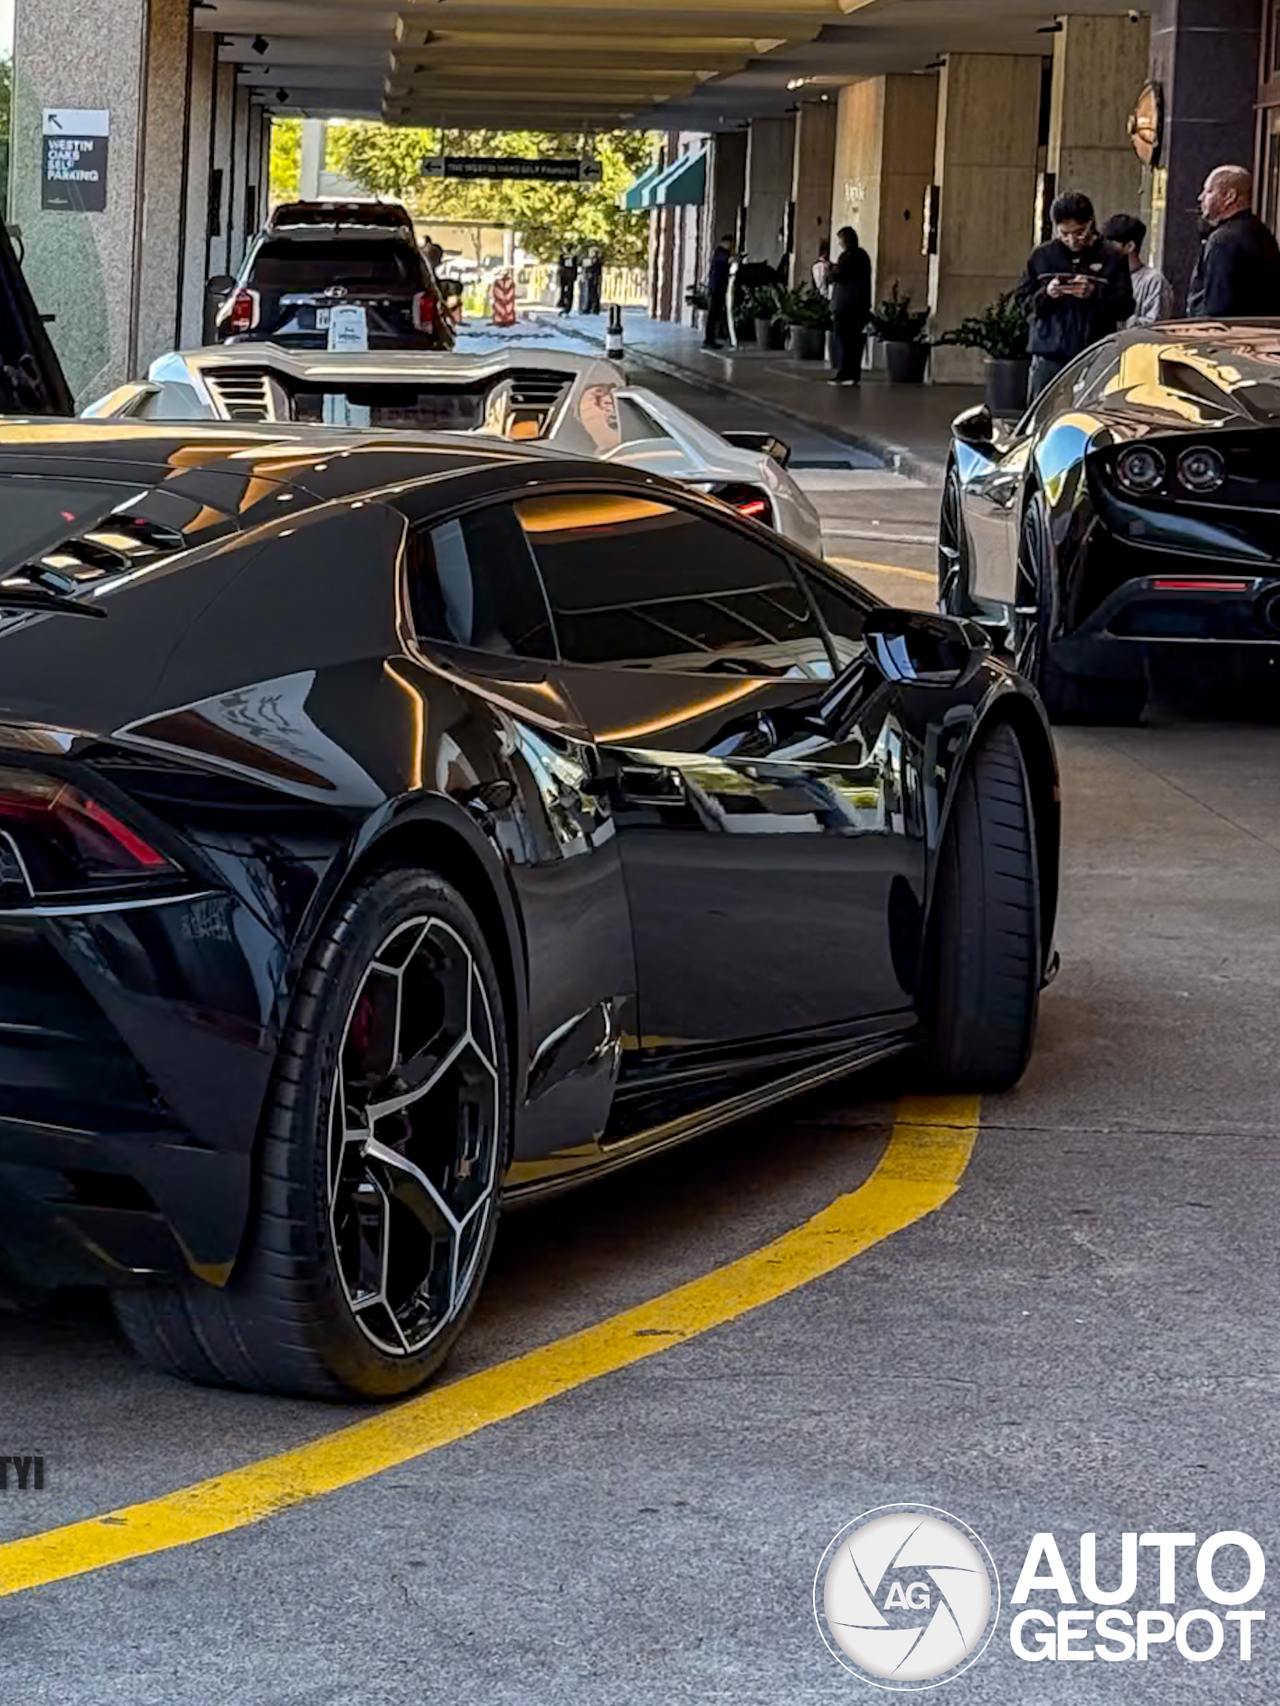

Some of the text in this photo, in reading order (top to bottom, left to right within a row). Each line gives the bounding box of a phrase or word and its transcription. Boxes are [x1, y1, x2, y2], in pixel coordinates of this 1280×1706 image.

[47, 140, 94, 151] WESTIN
[47, 150, 80, 161] OAKS
[47, 170, 99, 181] PARKING
